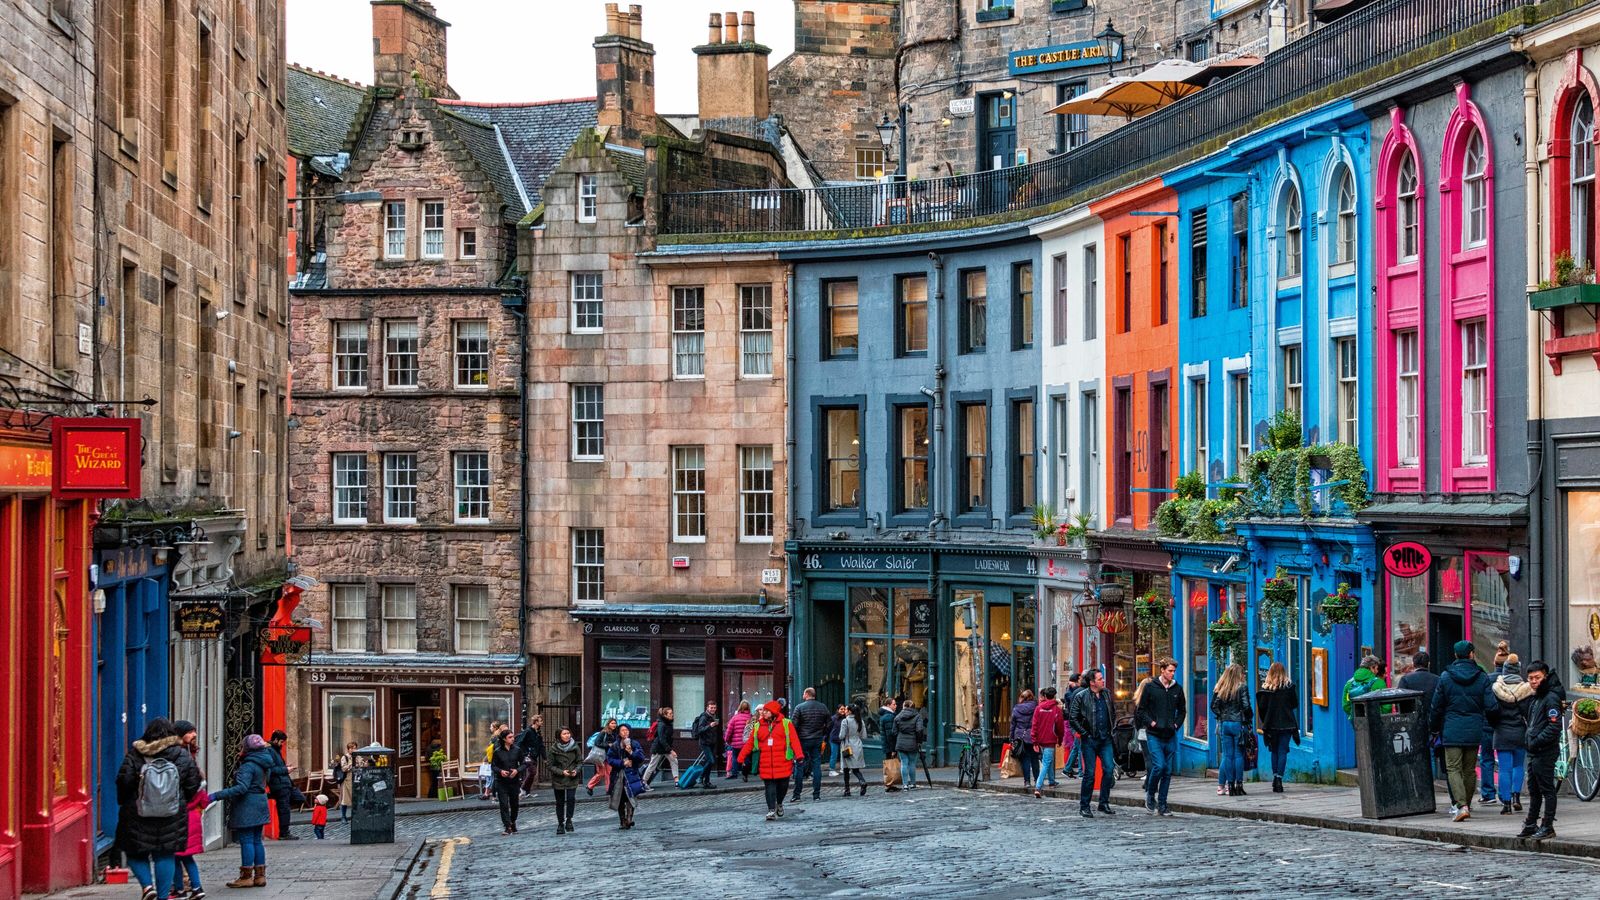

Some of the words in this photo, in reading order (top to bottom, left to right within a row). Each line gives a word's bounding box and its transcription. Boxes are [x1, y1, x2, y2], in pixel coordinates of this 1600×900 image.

[1014, 55, 1036, 67] THE
[1039, 48, 1076, 63] CASTLE
[803, 554, 822, 569] 46.
[840, 555, 879, 569] Walker
[885, 555, 918, 569] Slater
[974, 559, 1010, 571] LADIESWEAR
[311, 672, 327, 682] 89
[504, 675, 520, 685] 89
